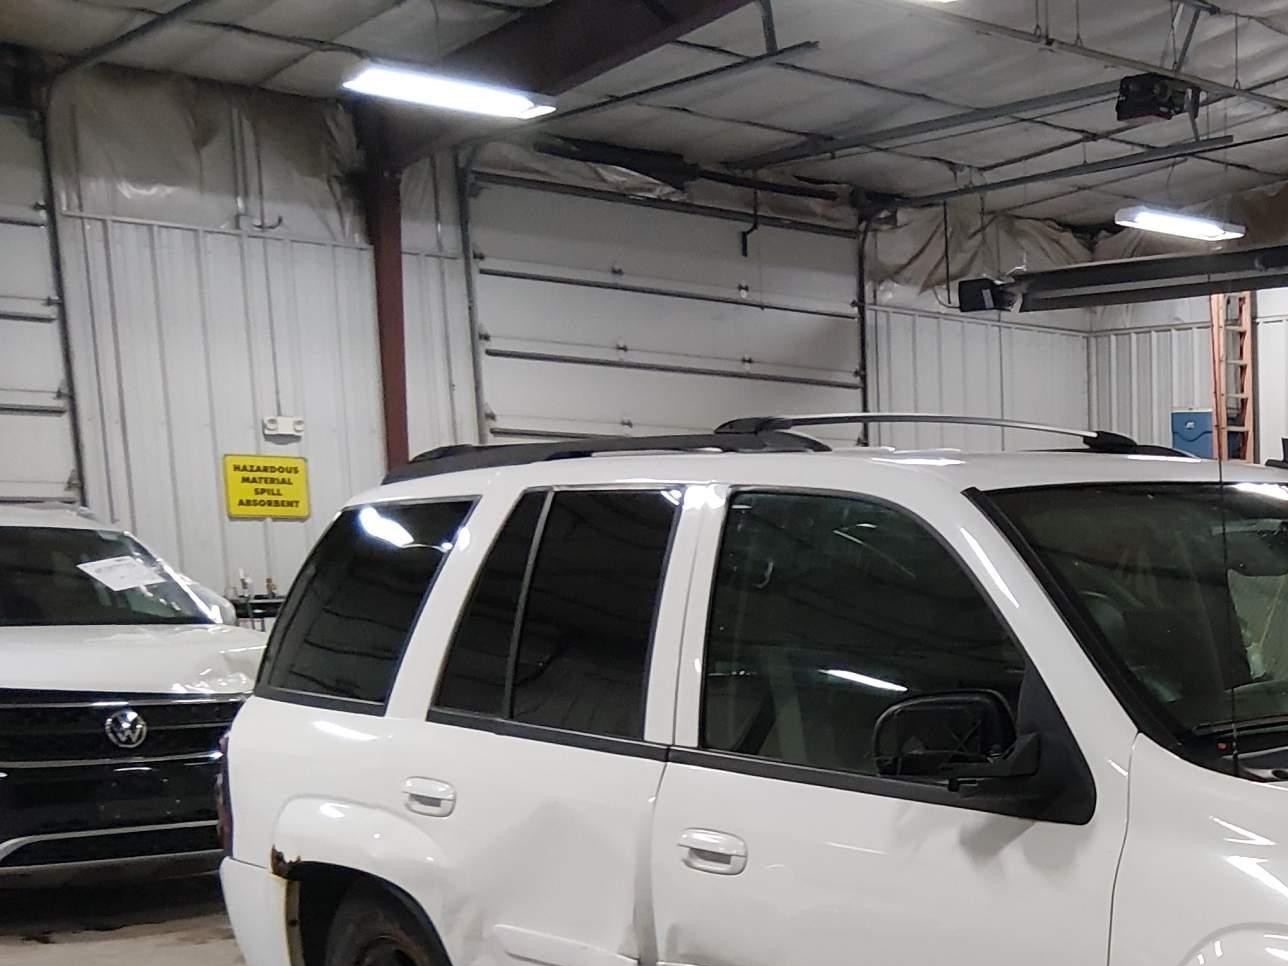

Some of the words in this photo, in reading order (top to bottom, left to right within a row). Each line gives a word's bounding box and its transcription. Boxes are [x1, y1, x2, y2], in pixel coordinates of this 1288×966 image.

[232, 464, 299, 474] HAZARDOUS
[240, 476, 293, 485] MATERIAL
[253, 487, 283, 496] SPILL
[238, 499, 300, 508] ABSORBENT
